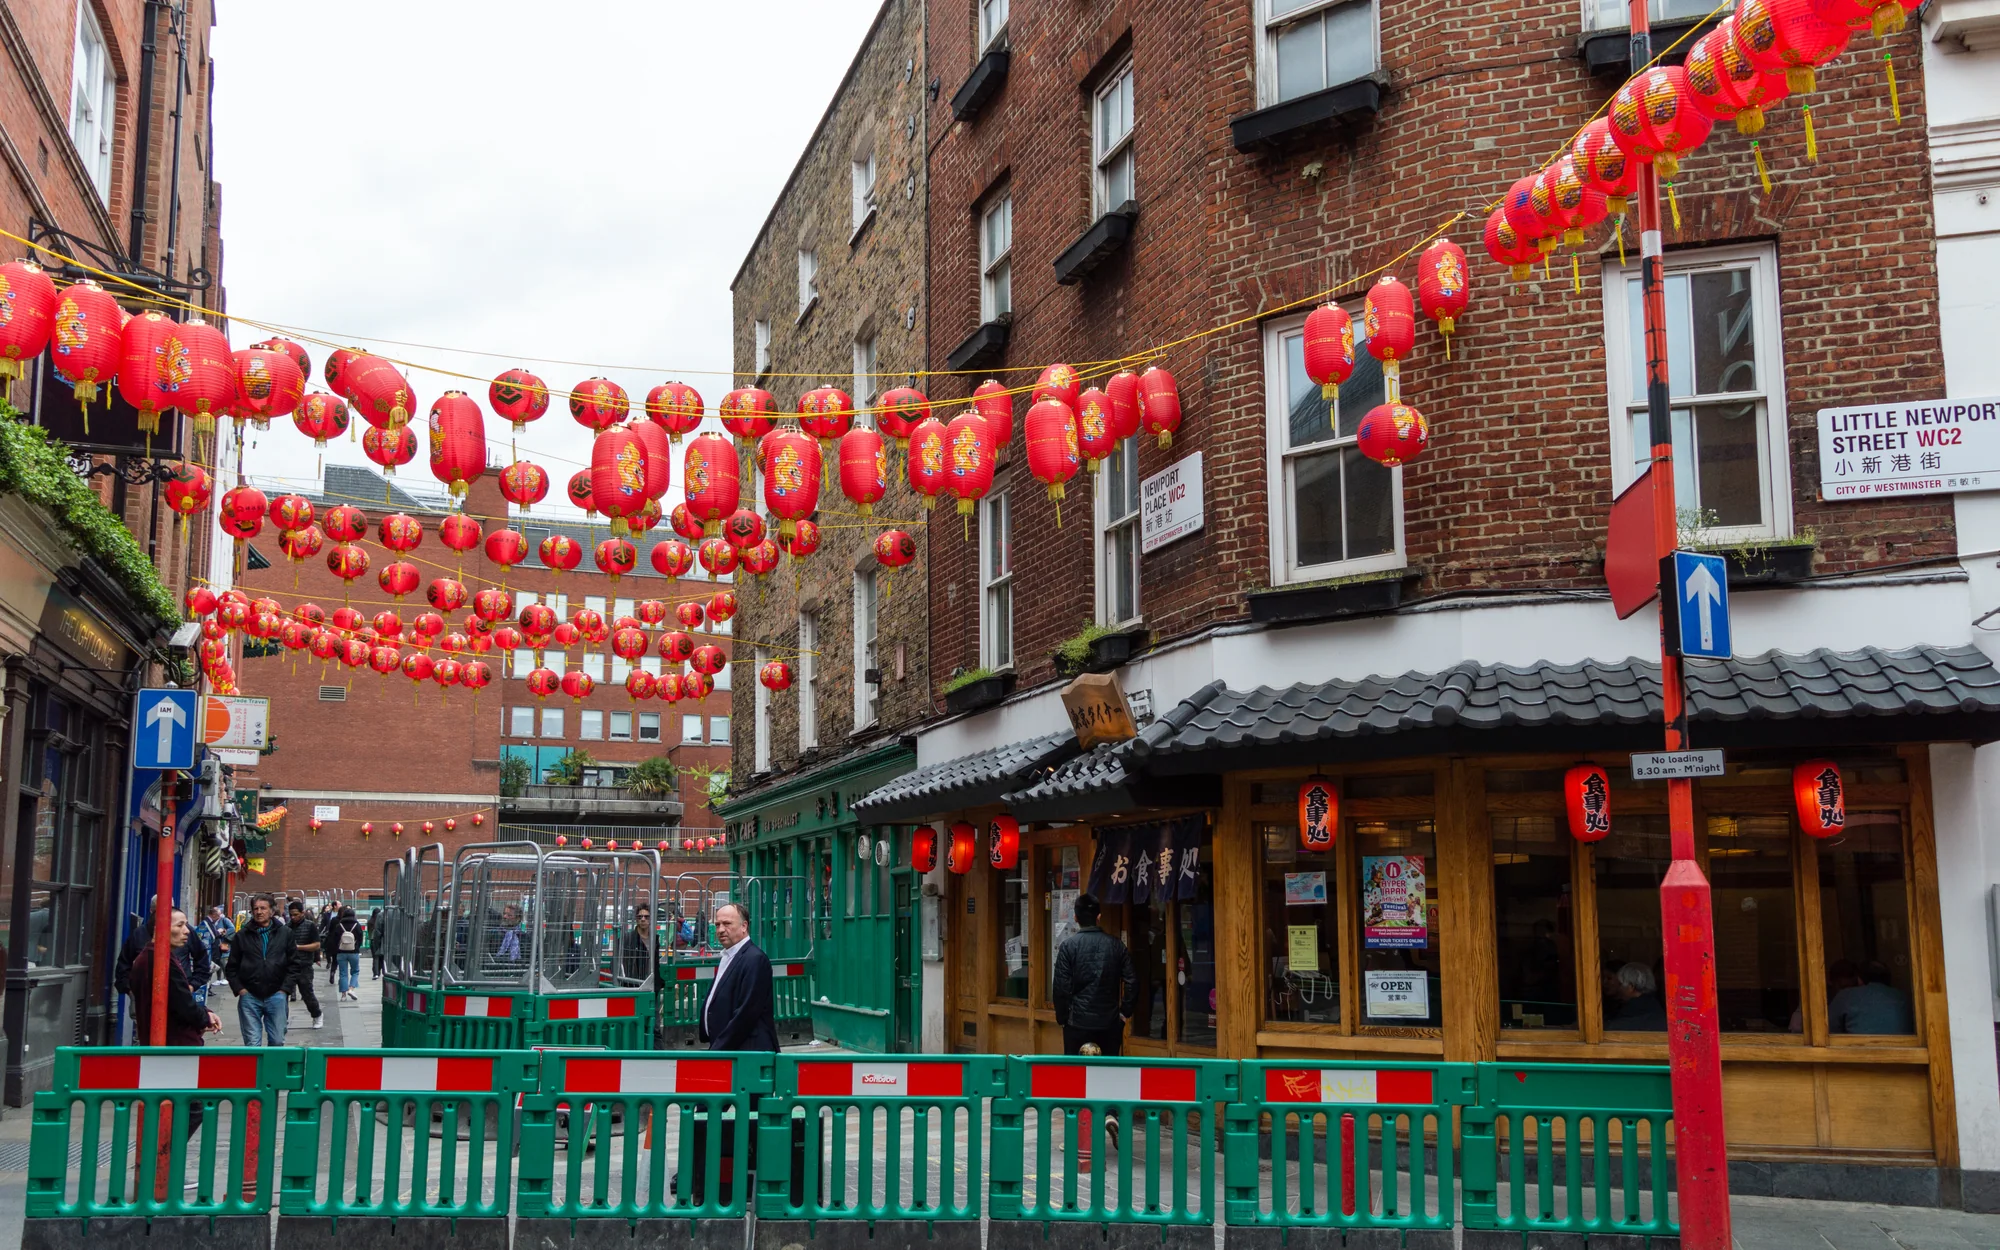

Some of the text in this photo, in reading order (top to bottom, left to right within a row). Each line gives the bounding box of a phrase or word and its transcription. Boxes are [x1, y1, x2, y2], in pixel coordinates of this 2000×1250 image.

[1831, 411, 1898, 432] LITTLE
[1832, 428, 1962, 454] STREET WC2
[1834, 451, 1941, 476] 小新港街
[1144, 468, 1180, 499] NEWPORT
[1836, 485, 1857, 495] CITY
[1859, 484, 1871, 493] OF
[1874, 479, 1942, 492] WESTMINSTER
[1145, 483, 1186, 516] PLACE WC2
[1145, 508, 1173, 534] 新港坊
[1146, 539, 1154, 549] CITY
[1153, 537, 1158, 546] OF
[1159, 526, 1183, 543] WESTMINSTER
[59, 609, 77, 638] THE
[90, 634, 117, 670] LOUNGE
[1636, 766, 1661, 776] 8.30
[1662, 767, 1677, 775] am
[1651, 754, 1704, 764] No loading
[1110, 846, 1200, 888] お食事処
[1382, 888, 1407, 896] JAPAN
[1381, 981, 1413, 991] OPEN
